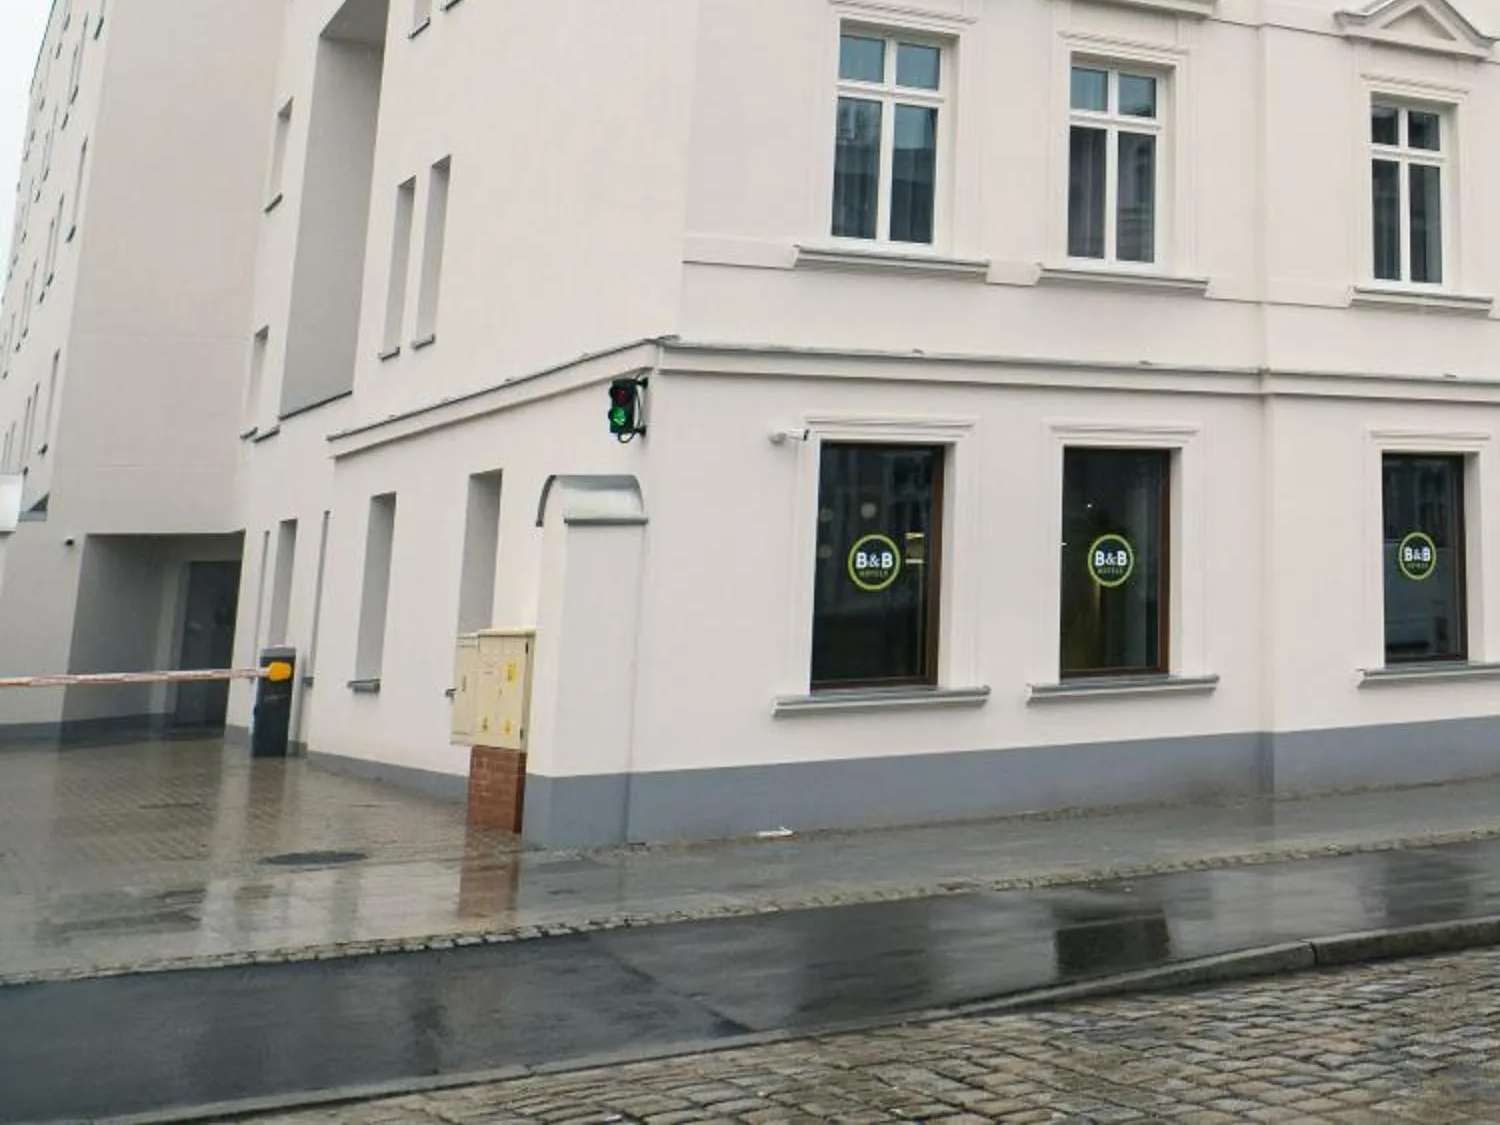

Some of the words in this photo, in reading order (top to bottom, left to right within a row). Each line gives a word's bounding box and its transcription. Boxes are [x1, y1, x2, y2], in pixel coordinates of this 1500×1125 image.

[855, 551, 893, 569] B&B
[1095, 550, 1127, 567] B&B
[1403, 546, 1431, 562] B&B
